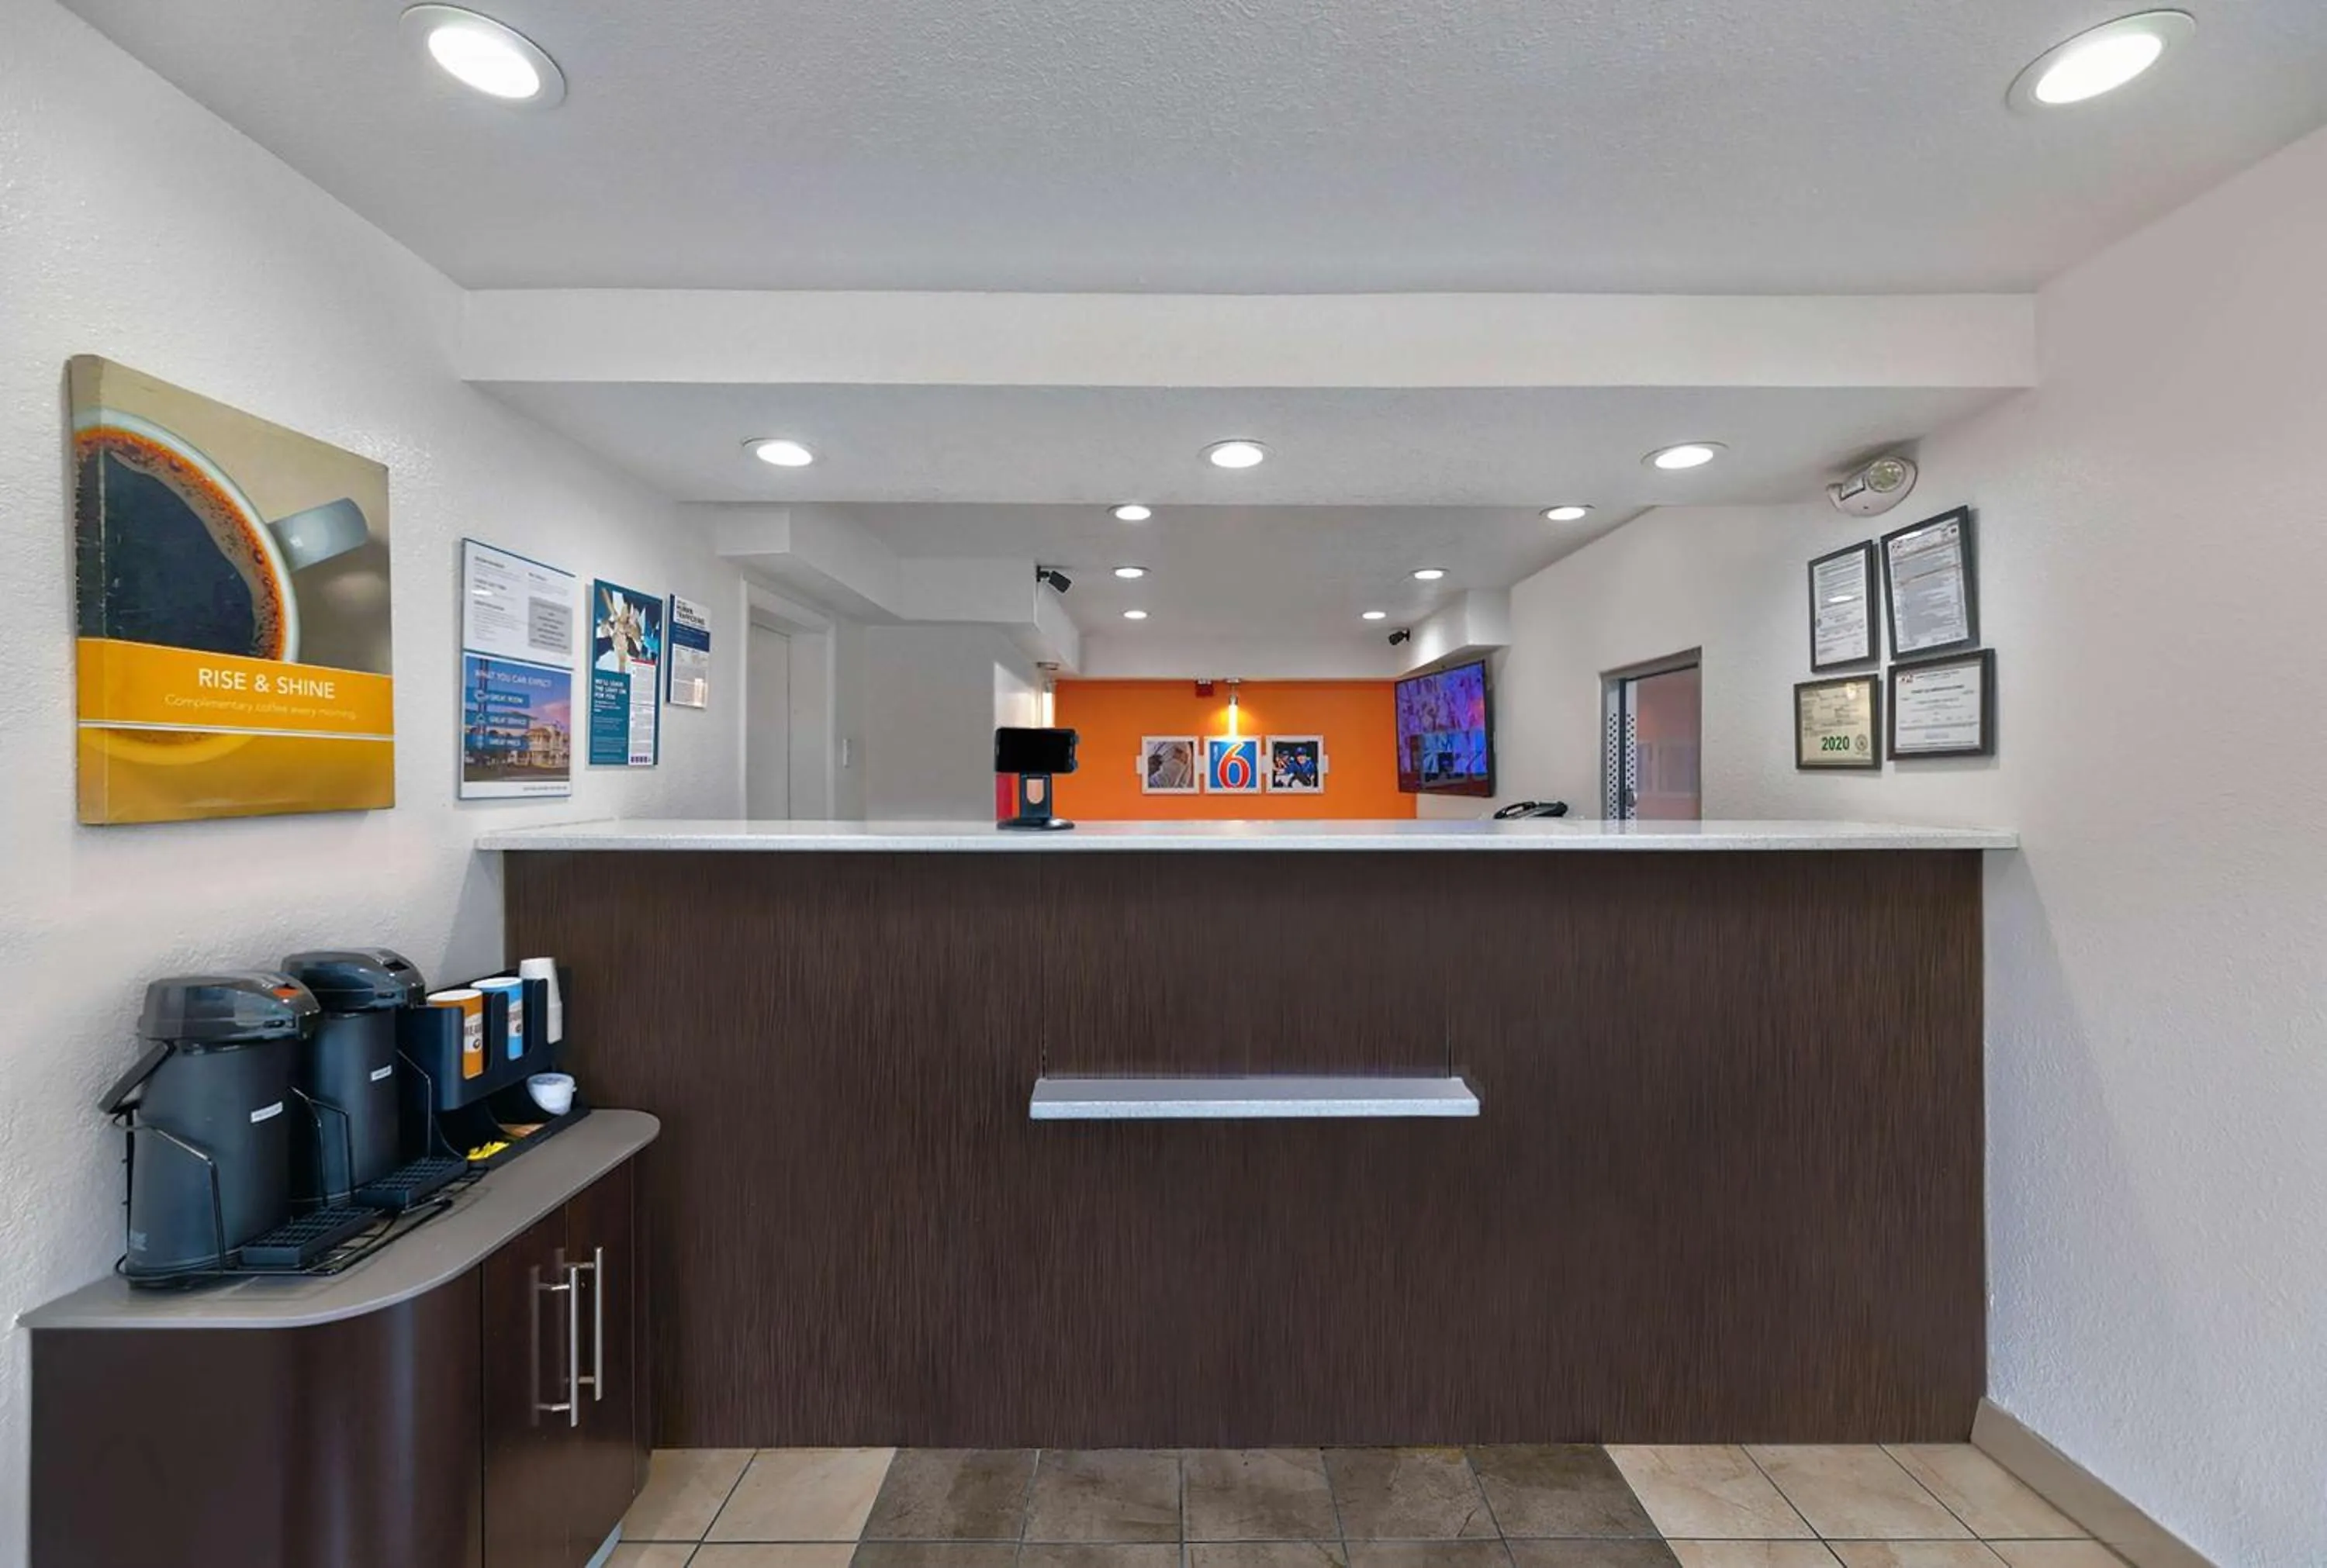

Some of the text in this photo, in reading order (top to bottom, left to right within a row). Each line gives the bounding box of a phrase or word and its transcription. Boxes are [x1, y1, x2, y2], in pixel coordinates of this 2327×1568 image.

[198, 668, 336, 699] RISE & SHINE
[496, 673, 511, 682] YOU
[512, 675, 527, 684] CAN
[164, 694, 253, 714] Complimentary
[254, 702, 288, 713] coffee
[1821, 734, 1850, 751] 2020
[1218, 742, 1251, 789] 6
